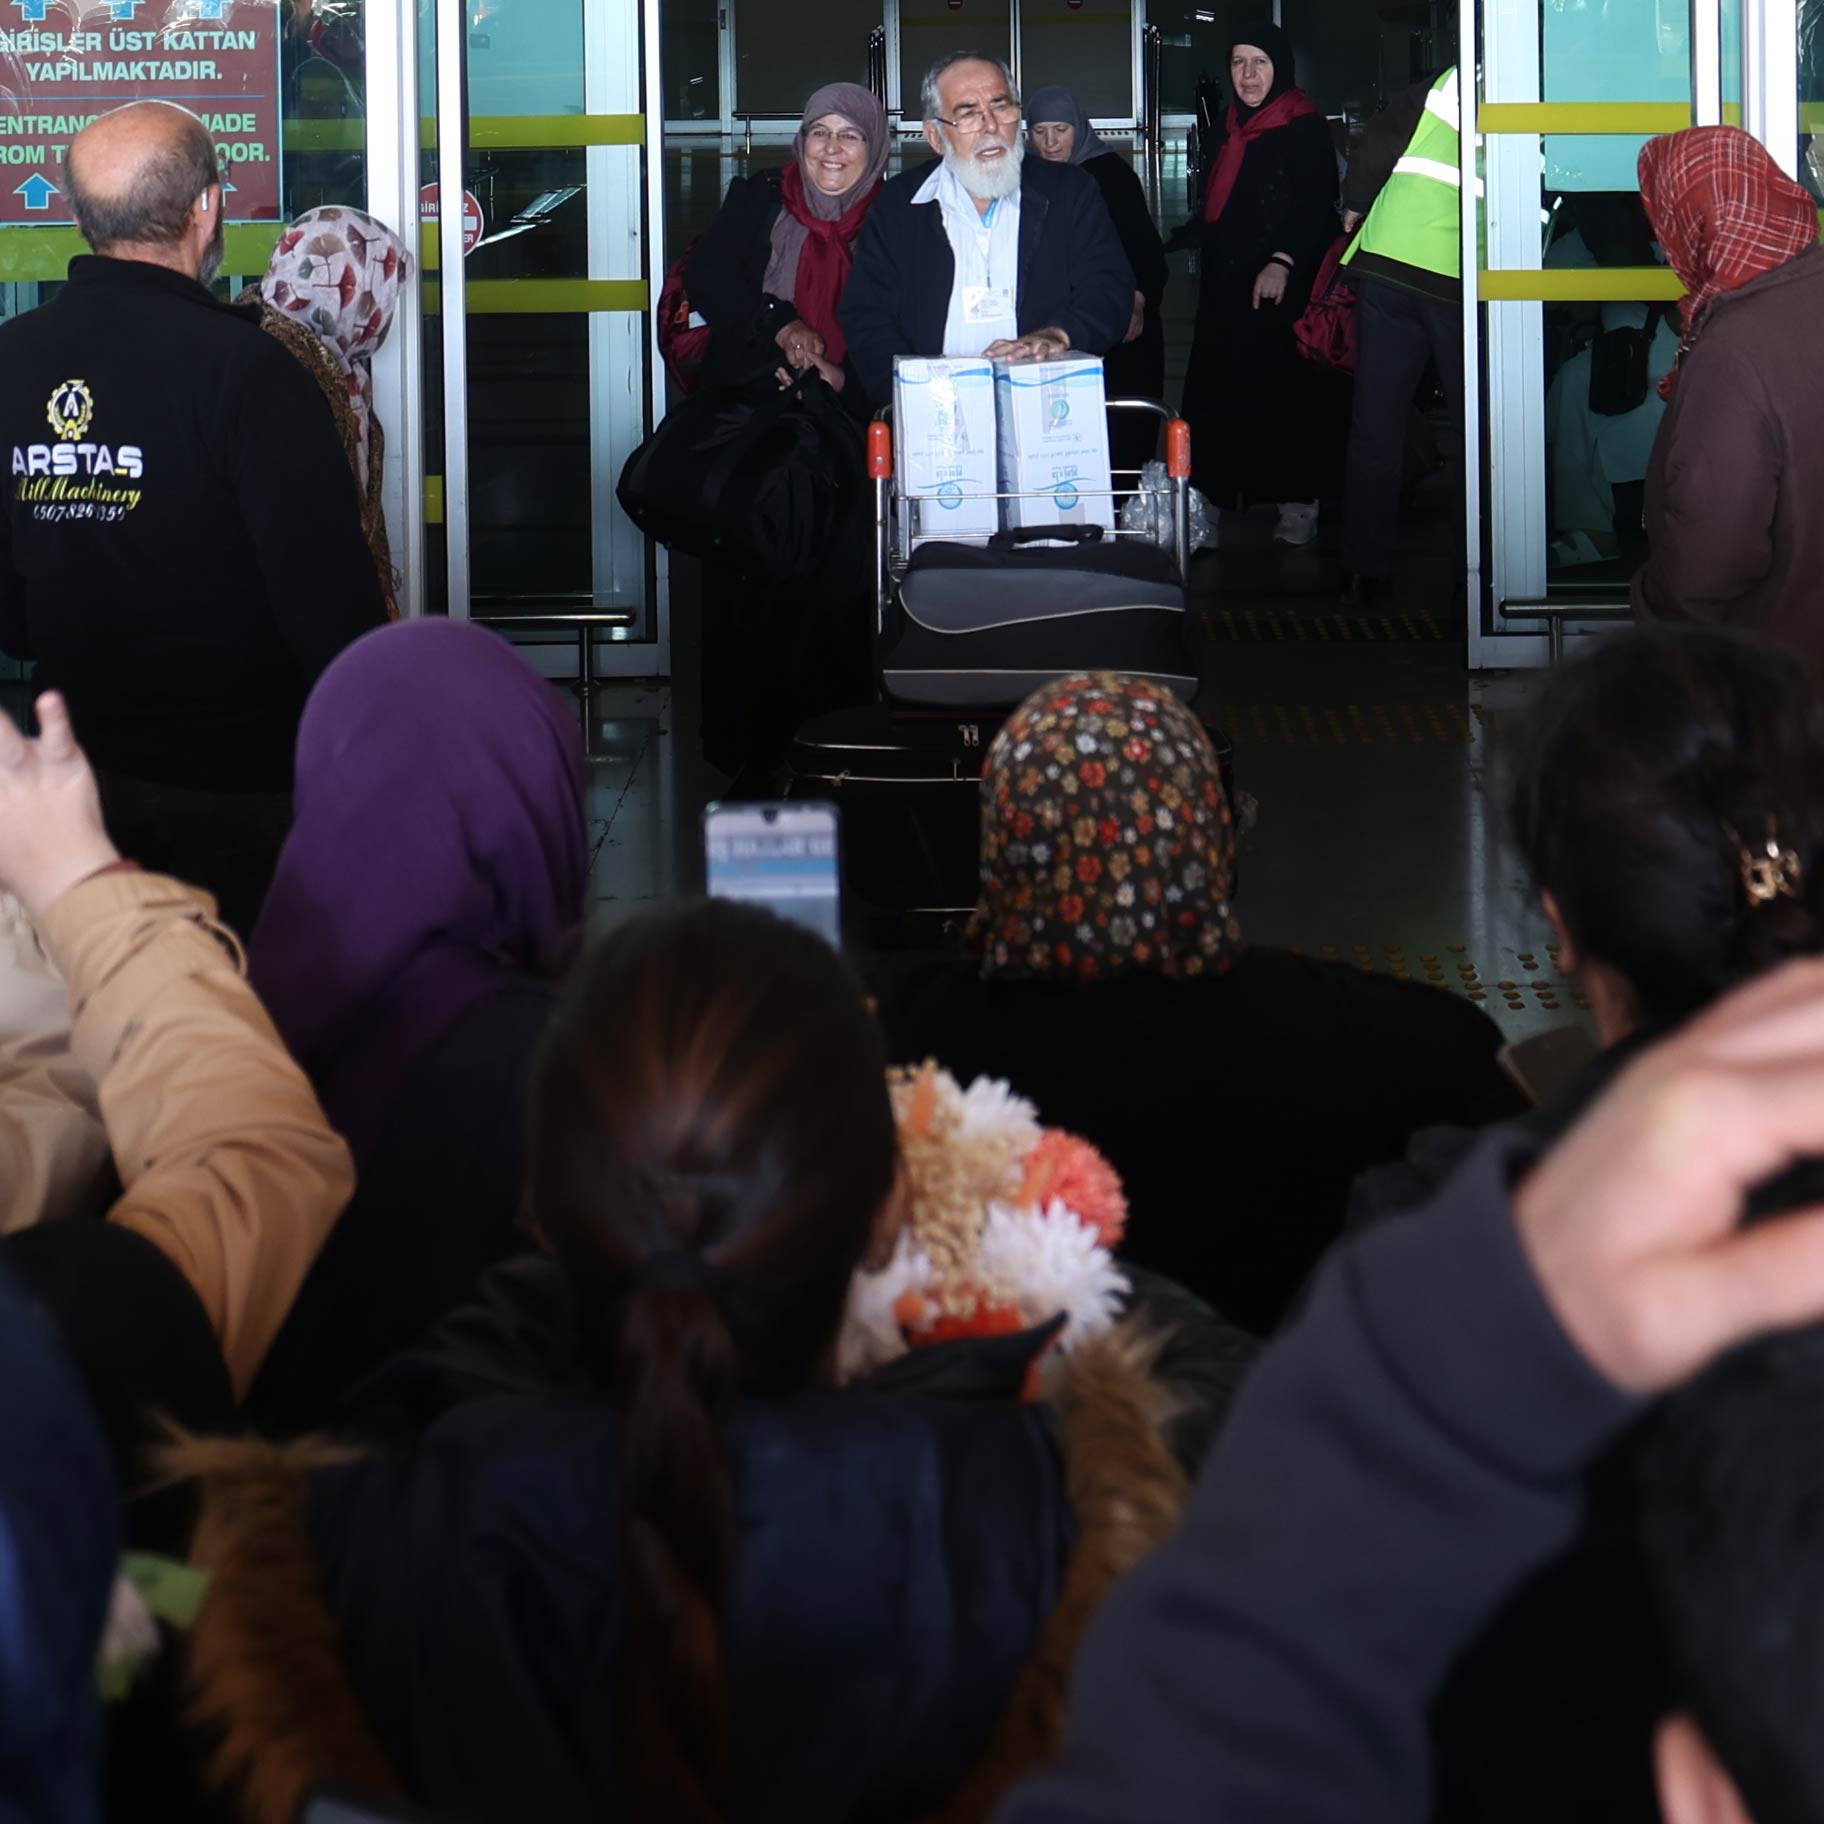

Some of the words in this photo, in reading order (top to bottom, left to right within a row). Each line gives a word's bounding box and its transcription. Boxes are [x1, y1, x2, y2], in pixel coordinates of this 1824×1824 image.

[110, 28, 156, 52] ÜST
[163, 30, 257, 50] KATTAN
[26, 60, 223, 81] YAPILMAKTADIR.
[47, 477, 142, 511] Machinery
